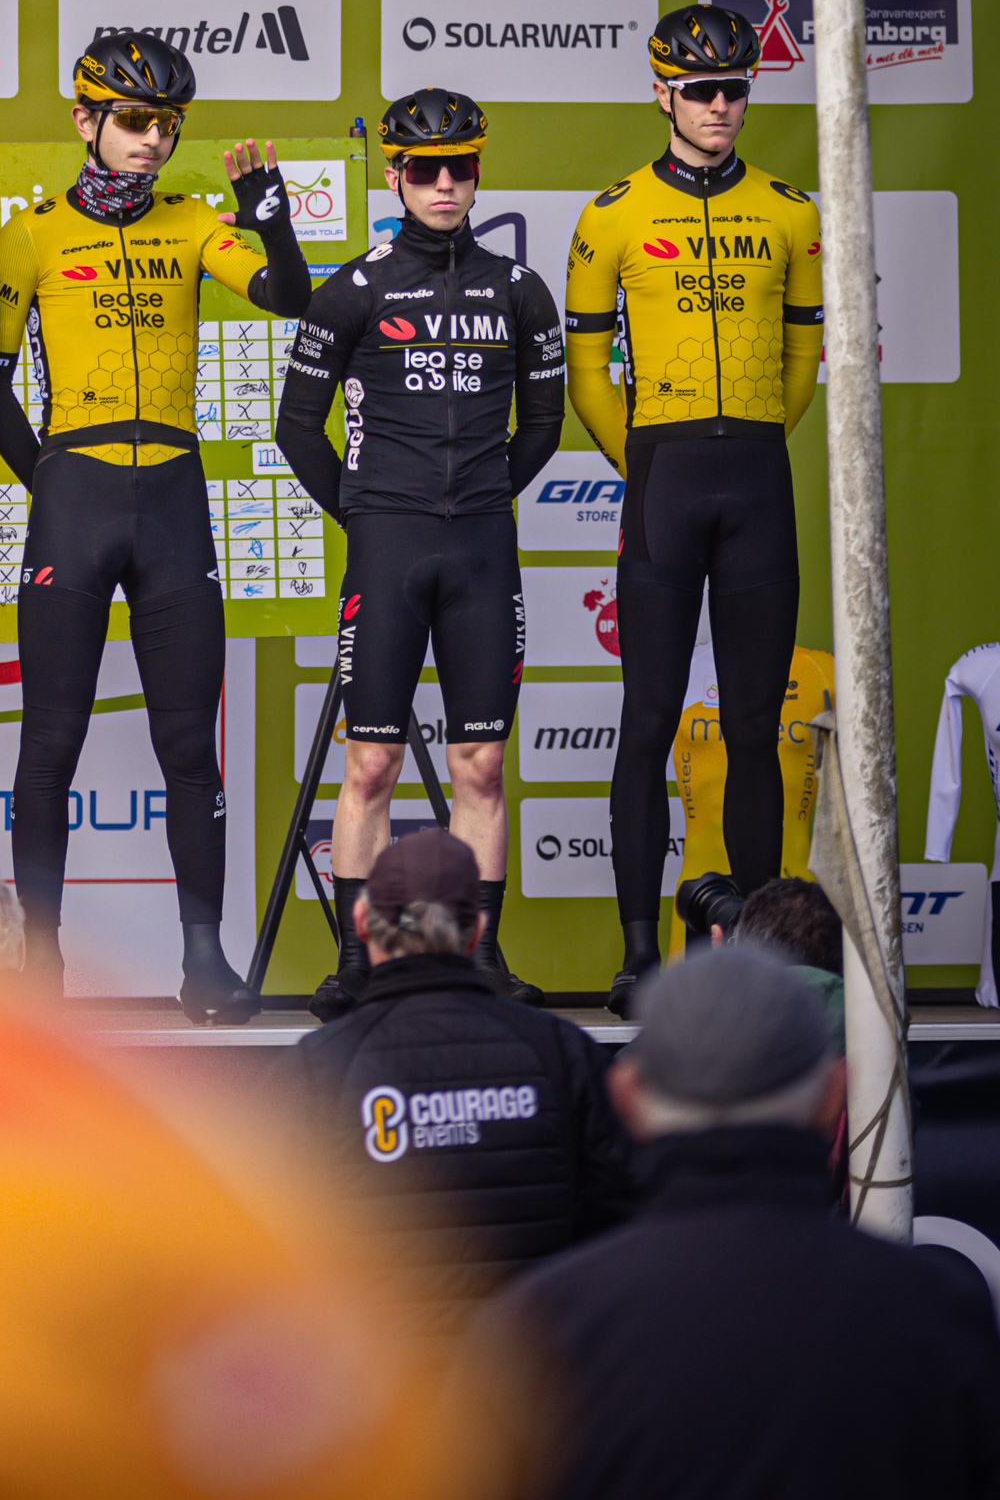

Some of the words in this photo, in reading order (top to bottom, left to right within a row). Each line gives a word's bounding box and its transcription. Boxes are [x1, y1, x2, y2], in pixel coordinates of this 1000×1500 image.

[445, 22, 624, 49] SOLARWATT
[686, 236, 772, 260] VISMA
[105, 257, 183, 280] VISMA
[675, 271, 745, 290] lease
[93, 291, 164, 308] lease
[308, 323, 335, 343] VISMA
[424, 314, 509, 341] VISMA
[405, 348, 483, 370] lease
[536, 480, 626, 504] GIA
[576, 510, 618, 522] STORE
[465, 722, 495, 732] AGU
[534, 727, 620, 750] man
